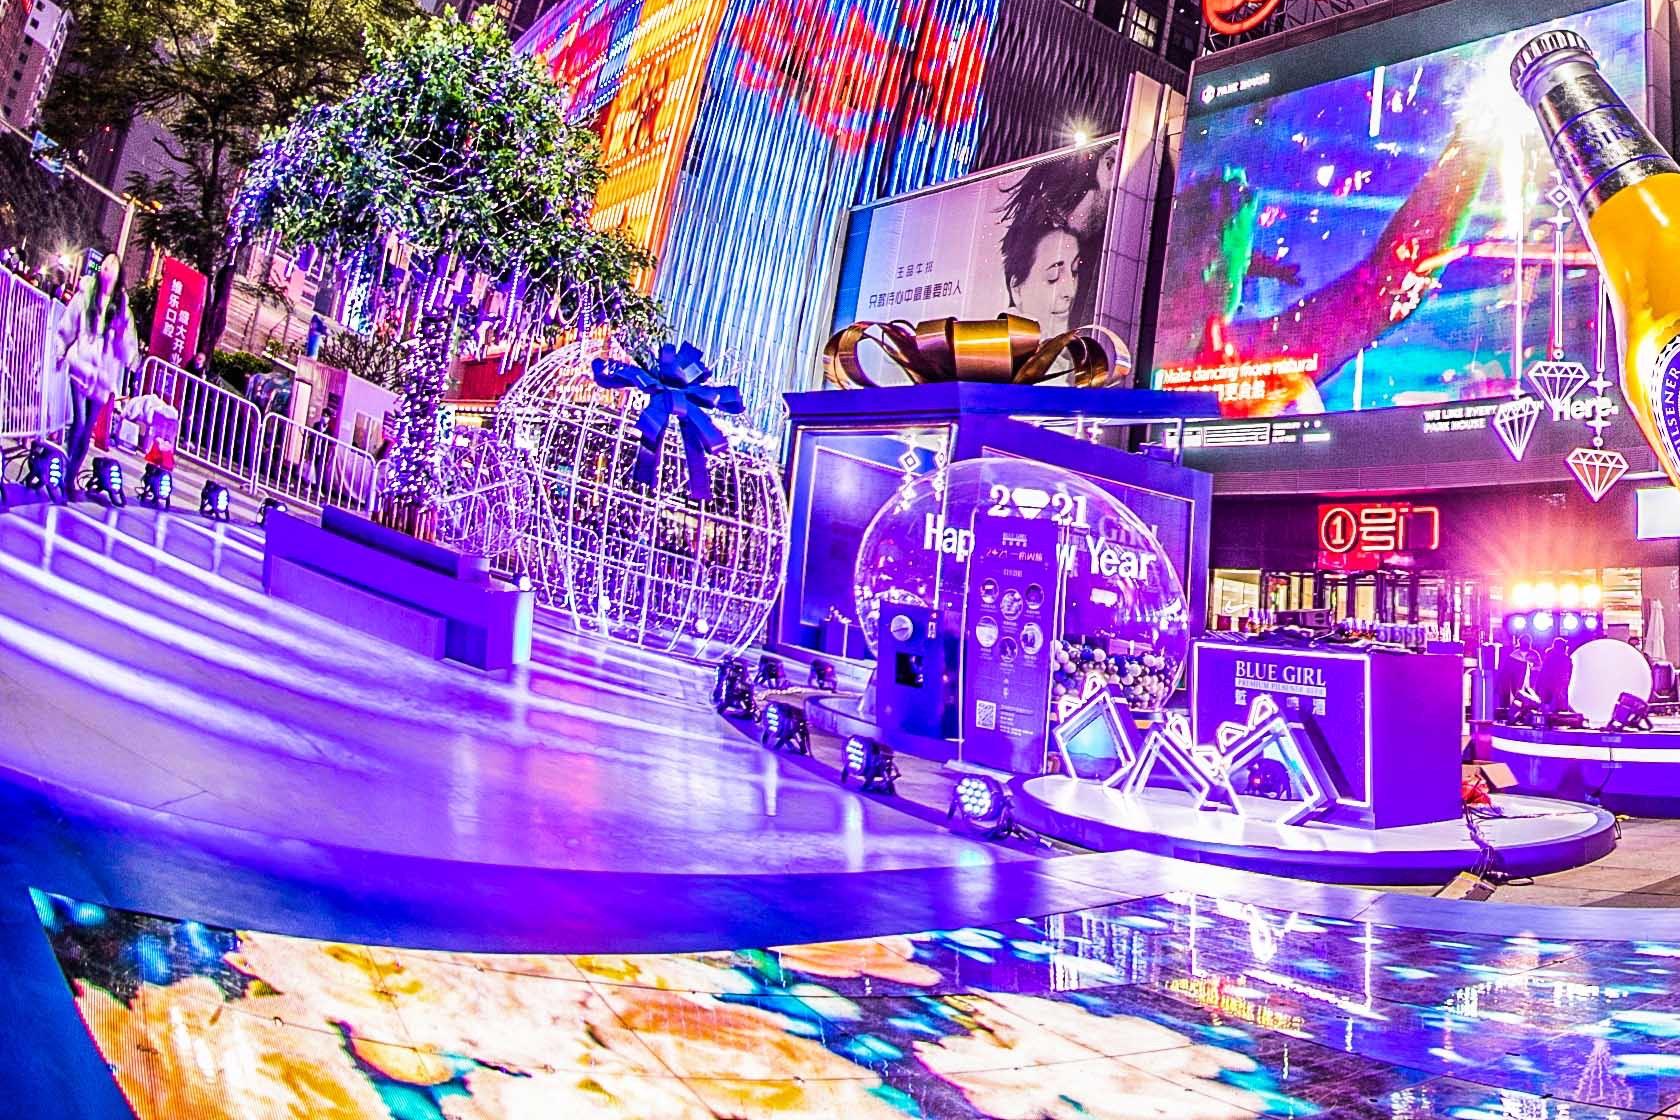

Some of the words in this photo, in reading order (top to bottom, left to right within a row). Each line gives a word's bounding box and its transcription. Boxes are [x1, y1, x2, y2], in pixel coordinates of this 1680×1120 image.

[1193, 365, 1240, 383] dancing
[1240, 361, 1273, 379] more
[1273, 353, 1319, 375] natural
[923, 512, 975, 563] Hap
[1086, 534, 1157, 581] Year
[1235, 660, 1278, 681] BLUE
[1282, 665, 1327, 687] GIRL
